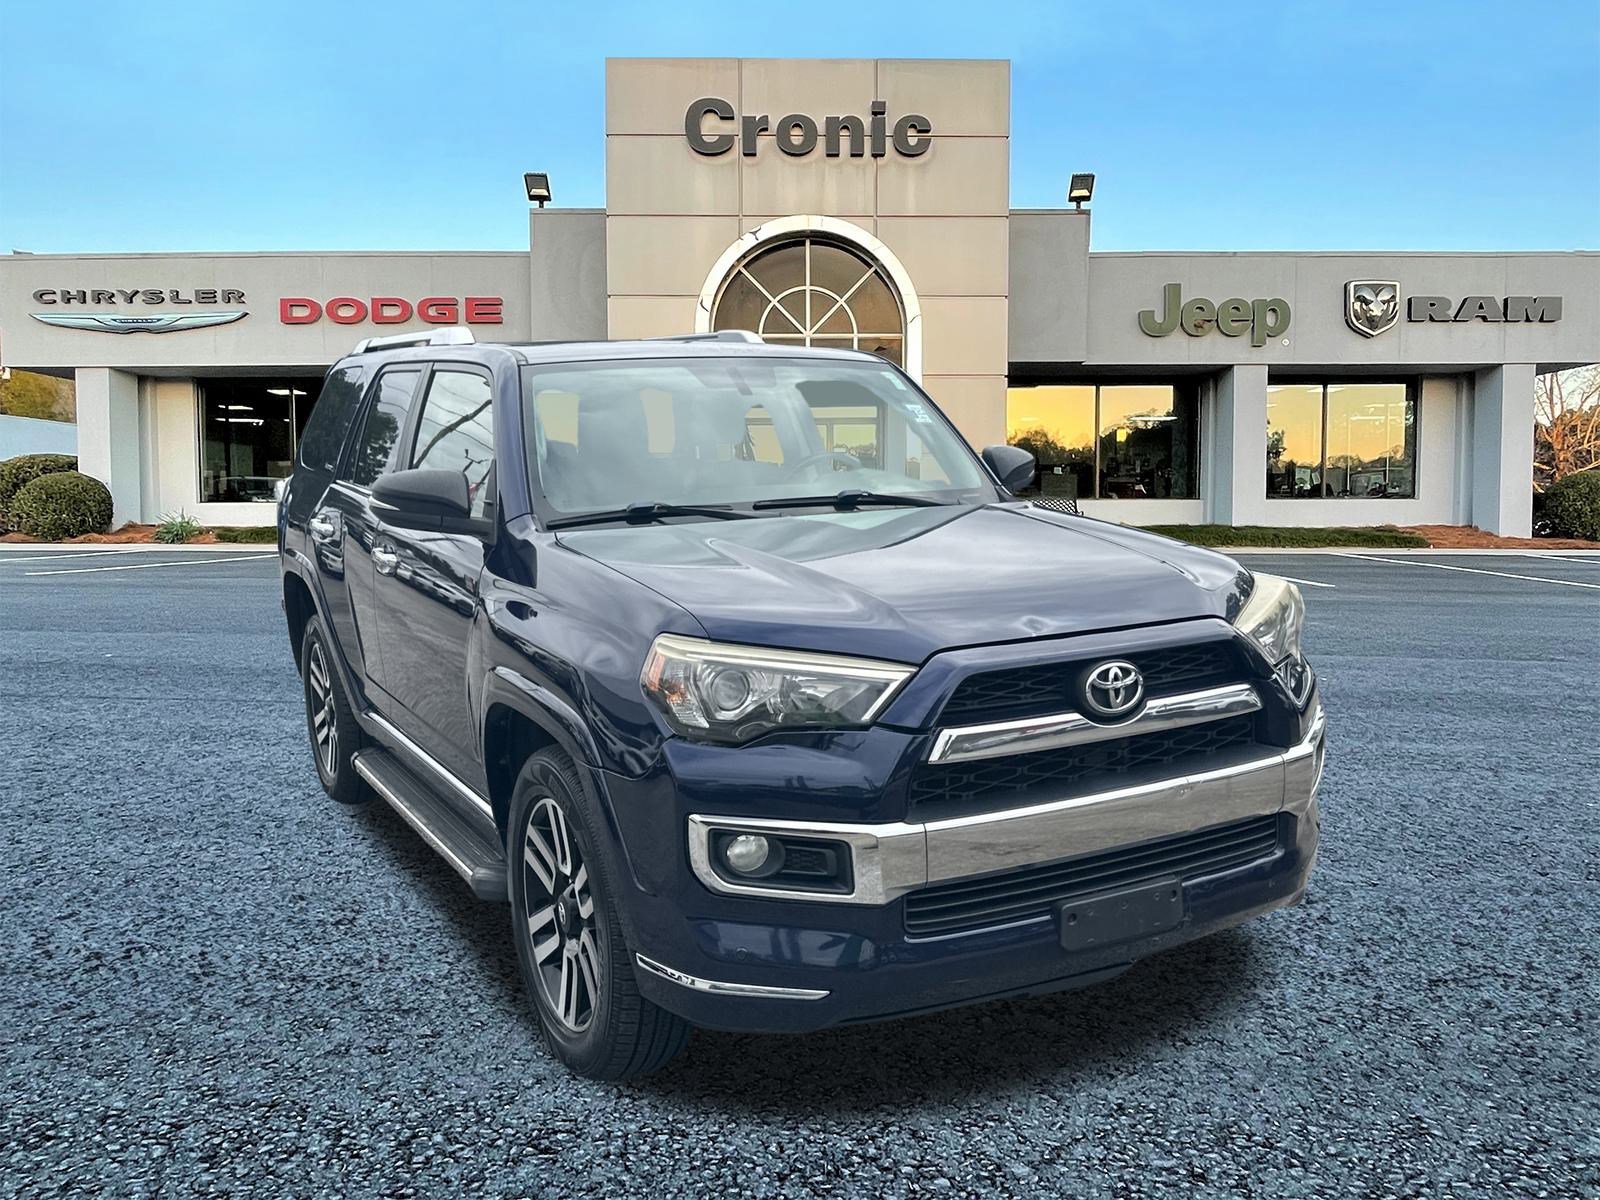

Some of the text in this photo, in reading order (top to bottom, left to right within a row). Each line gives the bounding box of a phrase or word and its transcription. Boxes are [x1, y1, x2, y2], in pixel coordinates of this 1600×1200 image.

[685, 97, 932, 157] Cronic
[32, 289, 246, 304] CHRYSLER
[1407, 296, 1563, 322] RAM
[279, 297, 503, 324] DODGE
[1138, 283, 1291, 347] Jeep
